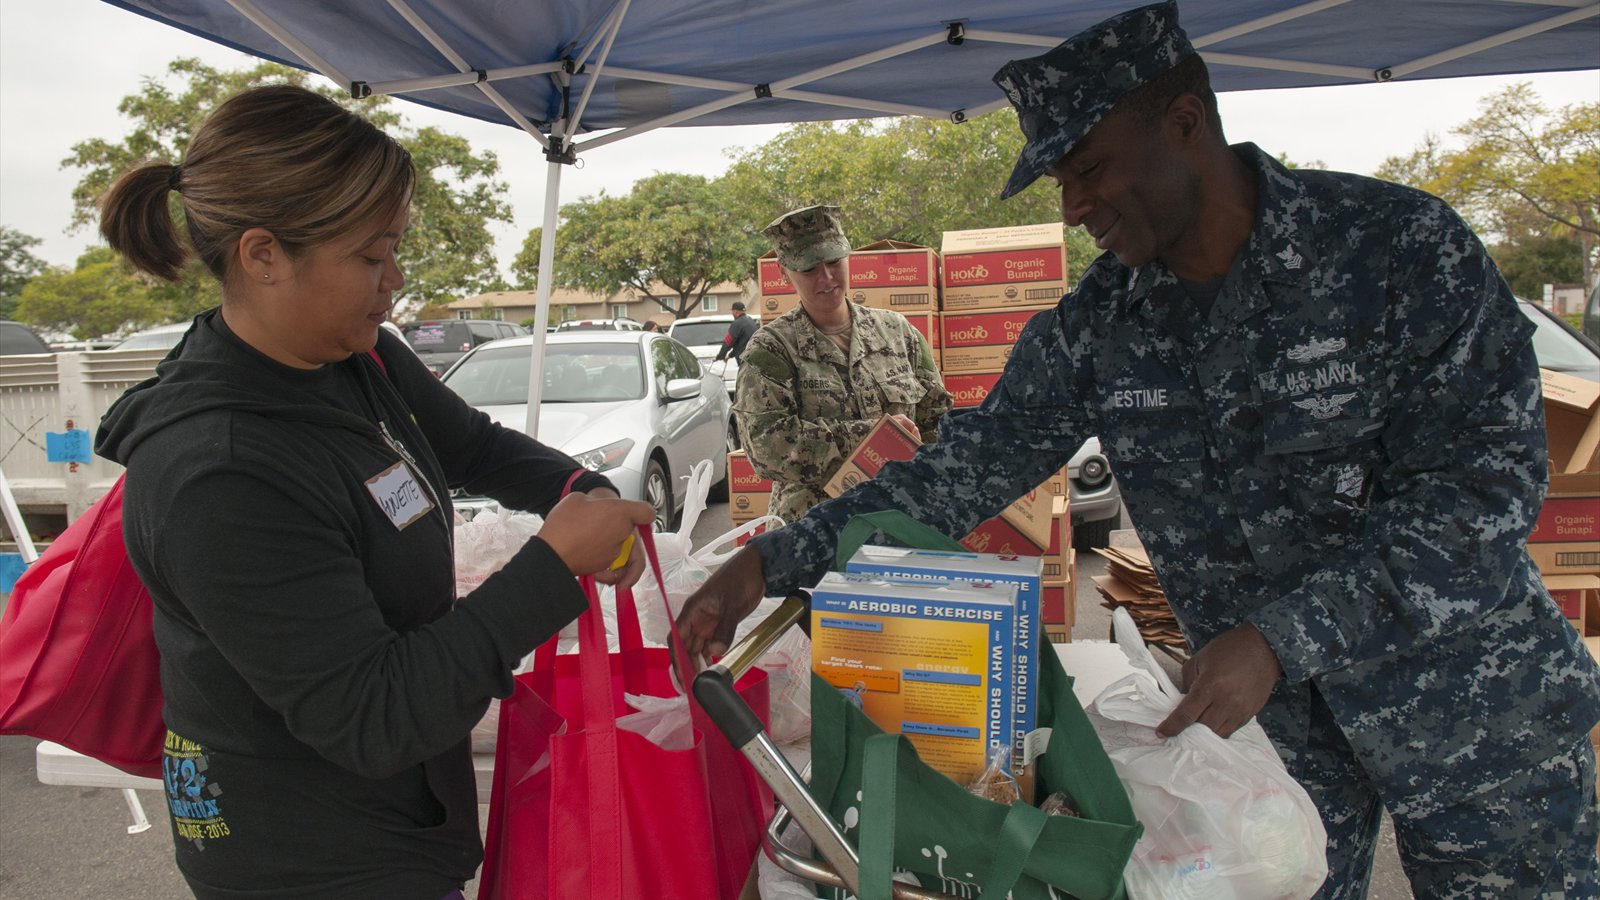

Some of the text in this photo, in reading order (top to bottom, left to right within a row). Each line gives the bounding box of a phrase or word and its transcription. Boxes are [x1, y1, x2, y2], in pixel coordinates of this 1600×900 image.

[888, 266, 918, 275] Organic
[1004, 257, 1045, 270] Organic
[1315, 362, 1357, 385] NAVY
[1114, 388, 1168, 408] ESTIME
[1554, 515, 1595, 527] Organic
[848, 600, 918, 615] AEROBIC
[923, 606, 1003, 621] EXERCISE
[1019, 614, 1029, 649] WHY
[992, 645, 1003, 682] WHY
[1017, 655, 1028, 714] SHOULD
[990, 688, 1002, 749] SHOULD
[1016, 730, 1025, 749] DO
[206, 822, 231, 839] 2013
